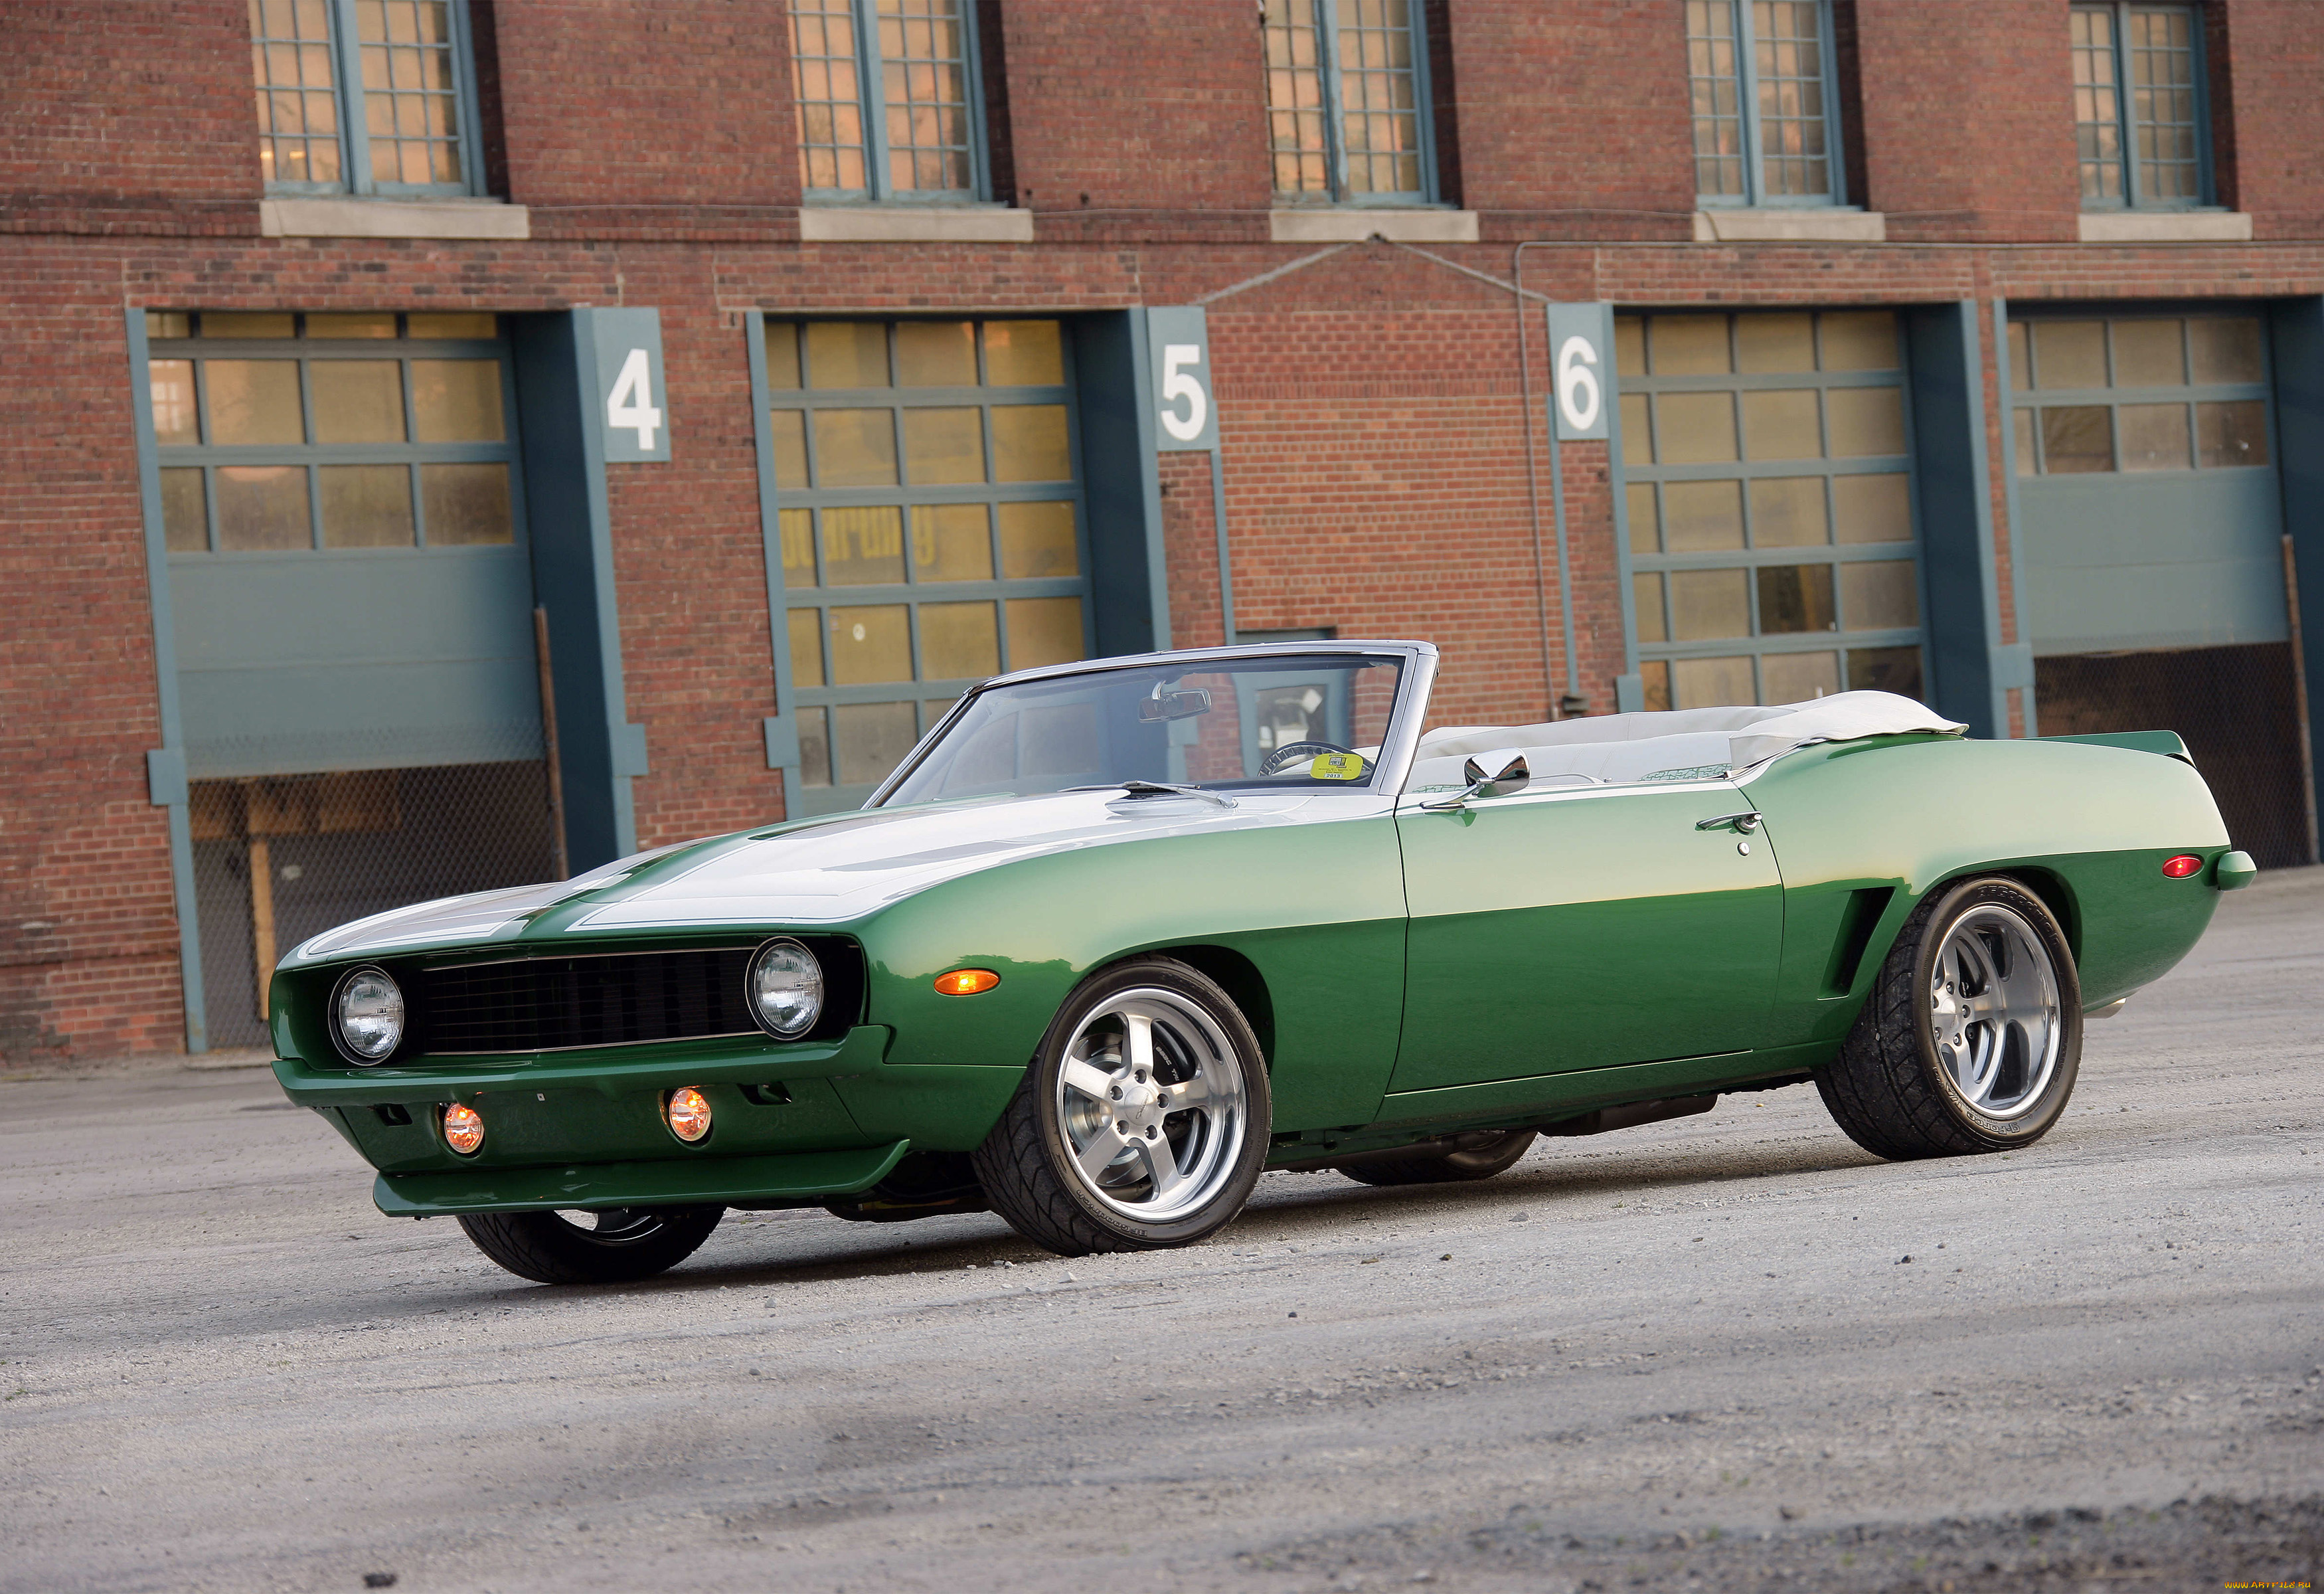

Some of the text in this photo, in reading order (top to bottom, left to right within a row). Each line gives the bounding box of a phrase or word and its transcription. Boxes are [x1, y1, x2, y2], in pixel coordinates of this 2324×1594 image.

[607, 348, 661, 450] 4
[1161, 344, 1207, 441] 5
[1558, 335, 1600, 430] 6
[1977, 885, 2060, 946] BFGoodrich
[1076, 1189, 1148, 1237] BFGoodrich
